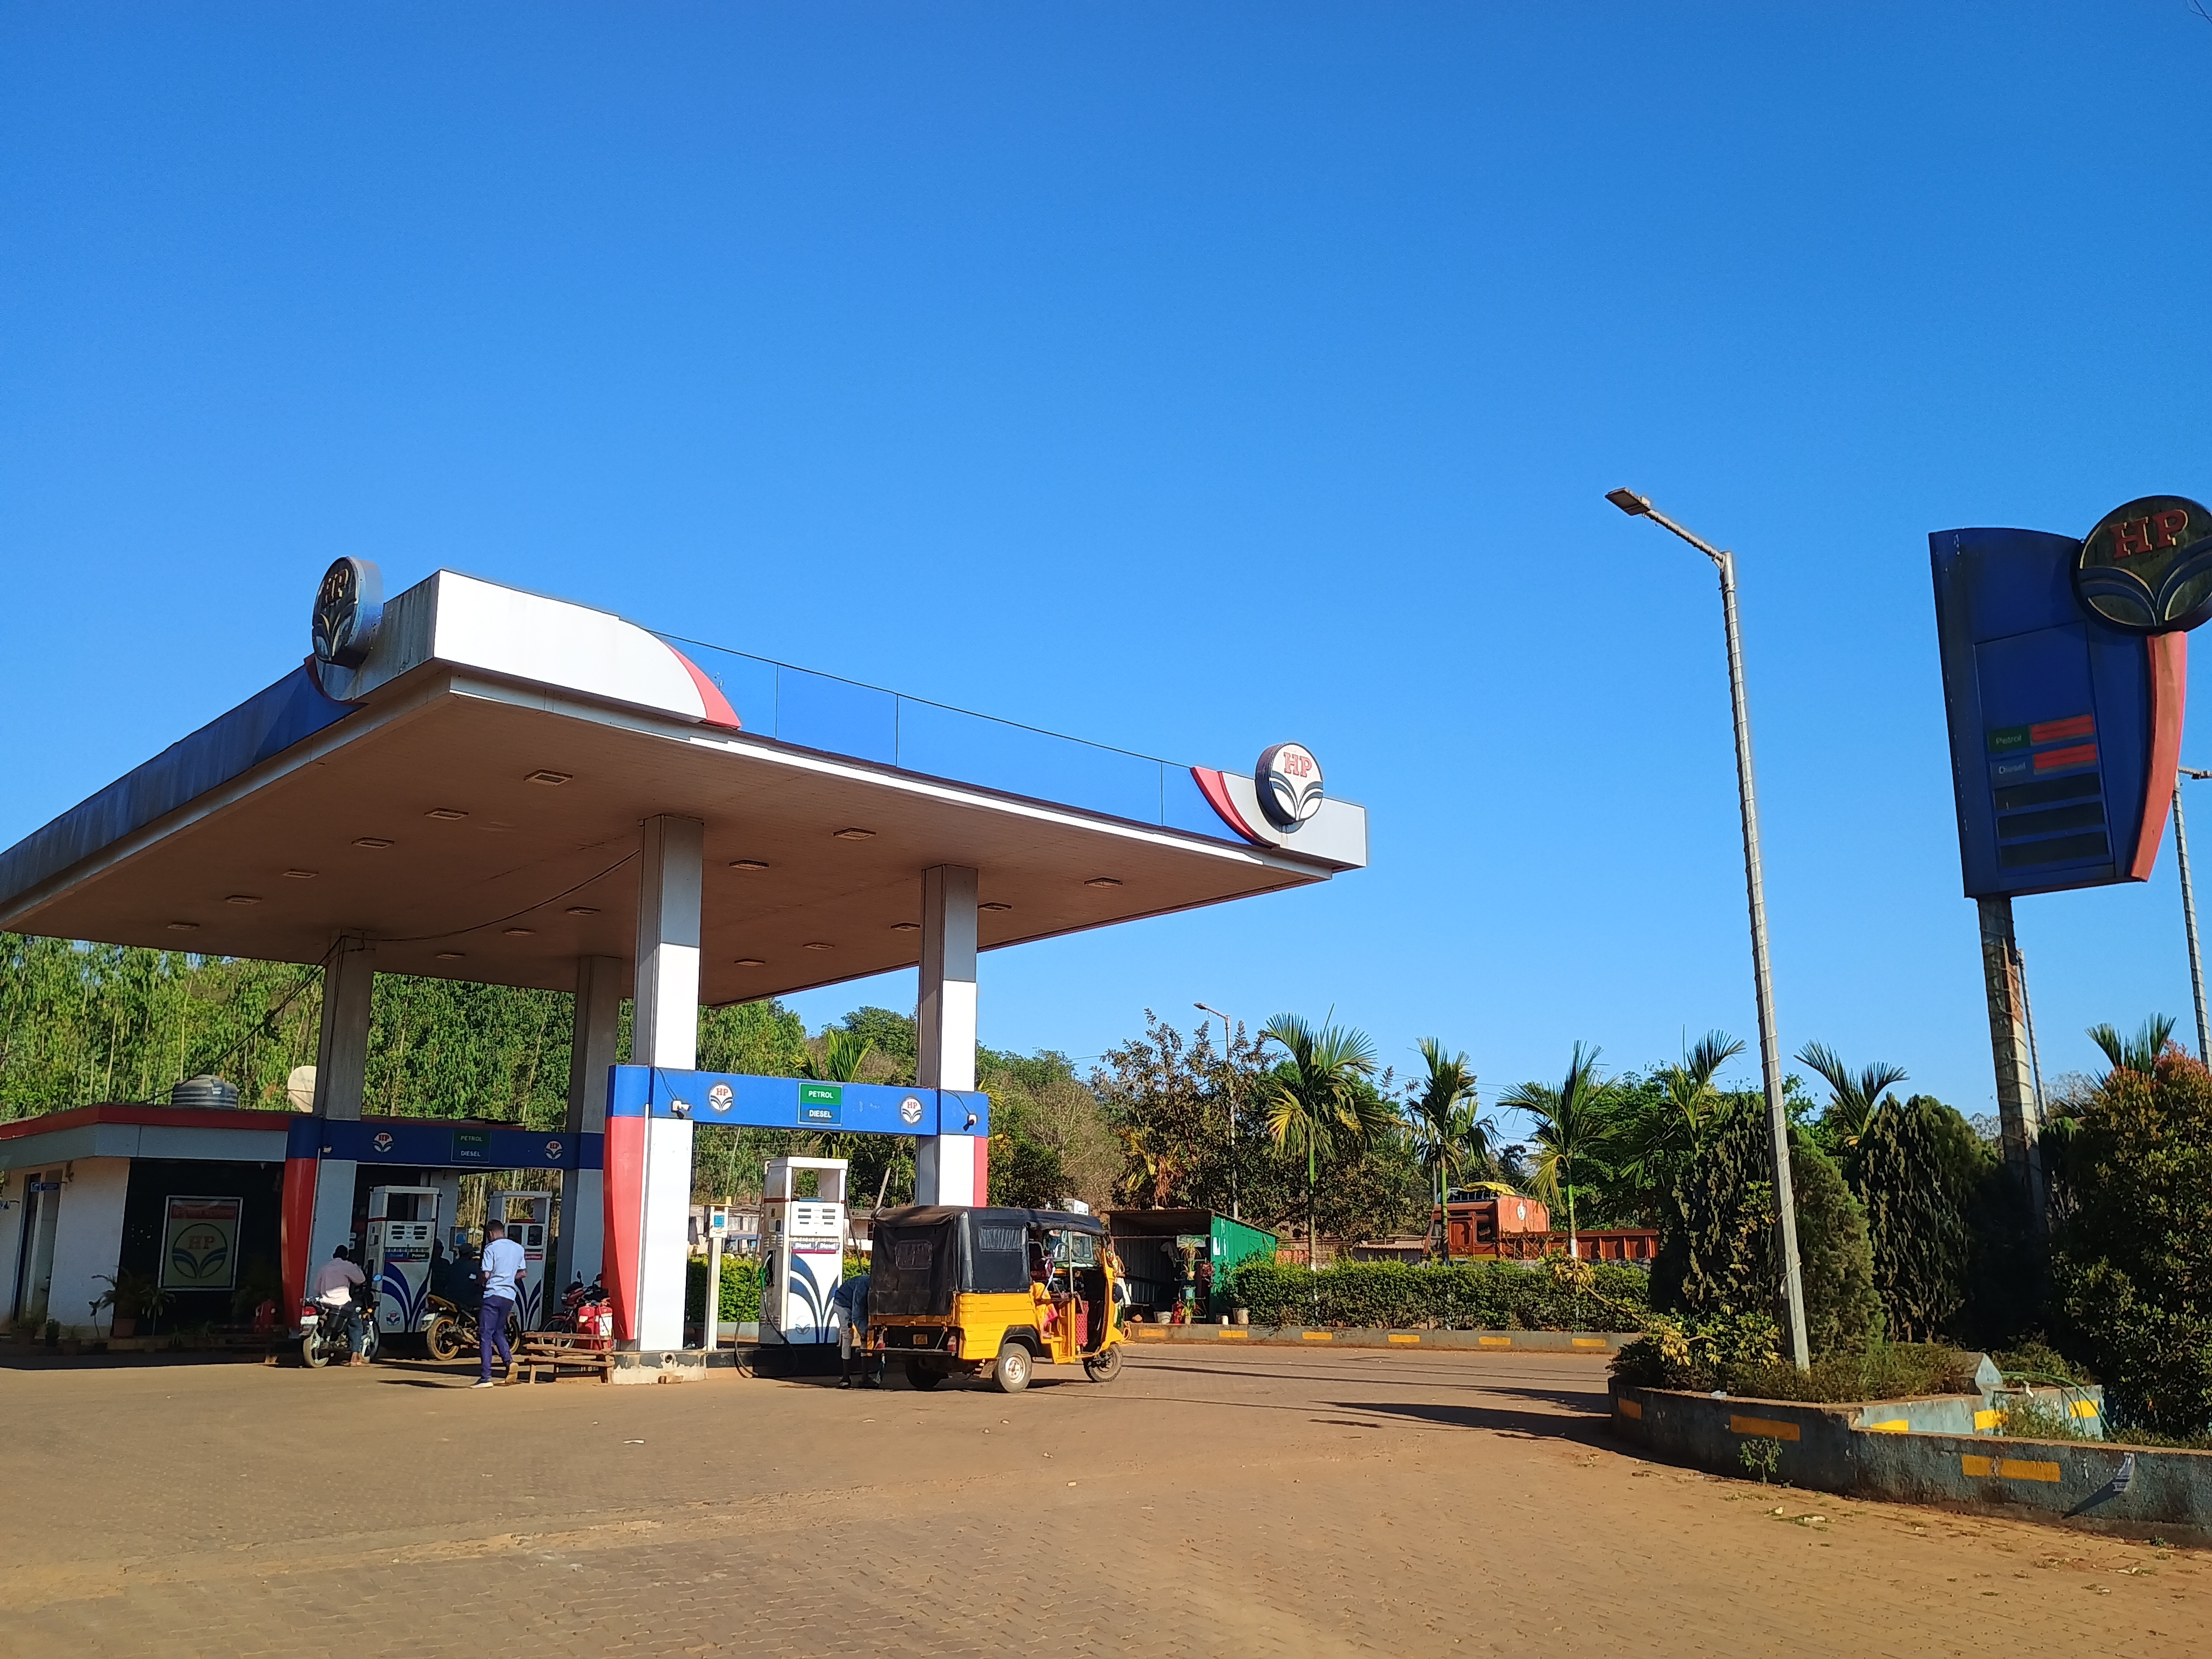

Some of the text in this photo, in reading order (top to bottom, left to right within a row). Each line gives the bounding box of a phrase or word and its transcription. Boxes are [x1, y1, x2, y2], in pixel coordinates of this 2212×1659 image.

[2109, 509, 2188, 558] HP
[322, 569, 349, 605] HP
[1995, 734, 2022, 745] Petrol
[1283, 751, 1312, 778] HP
[716, 1088, 729, 1096] HP
[808, 1090, 833, 1098] PETROL
[809, 1109, 832, 1118] DIESEL
[187, 1235, 215, 1250] HP
